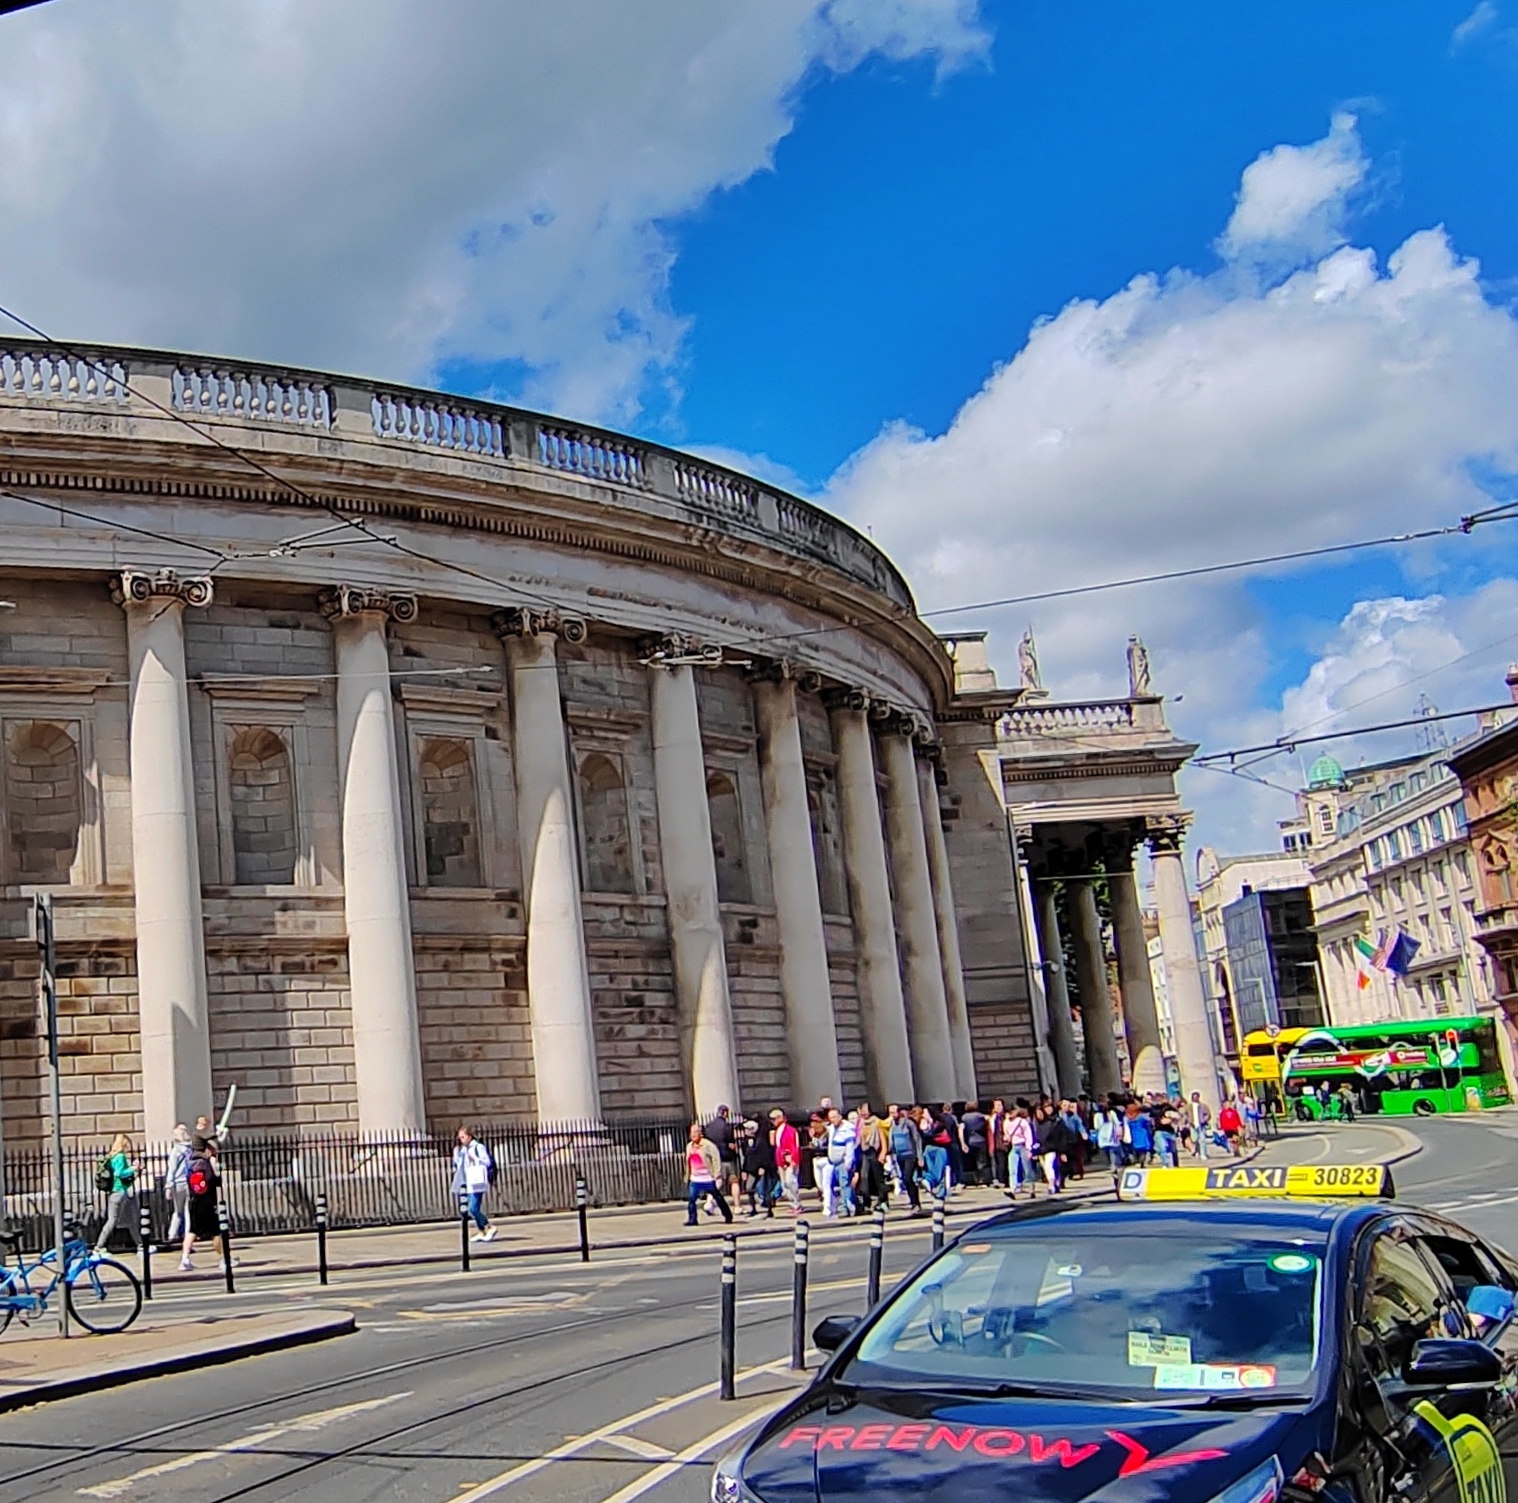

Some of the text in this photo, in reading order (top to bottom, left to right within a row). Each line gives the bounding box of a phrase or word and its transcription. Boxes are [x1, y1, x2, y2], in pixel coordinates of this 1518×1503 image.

[1213, 1168, 1281, 1188] TAXI
[1314, 1168, 1377, 1186] 30823
[779, 1424, 1100, 1468] FREENOW
